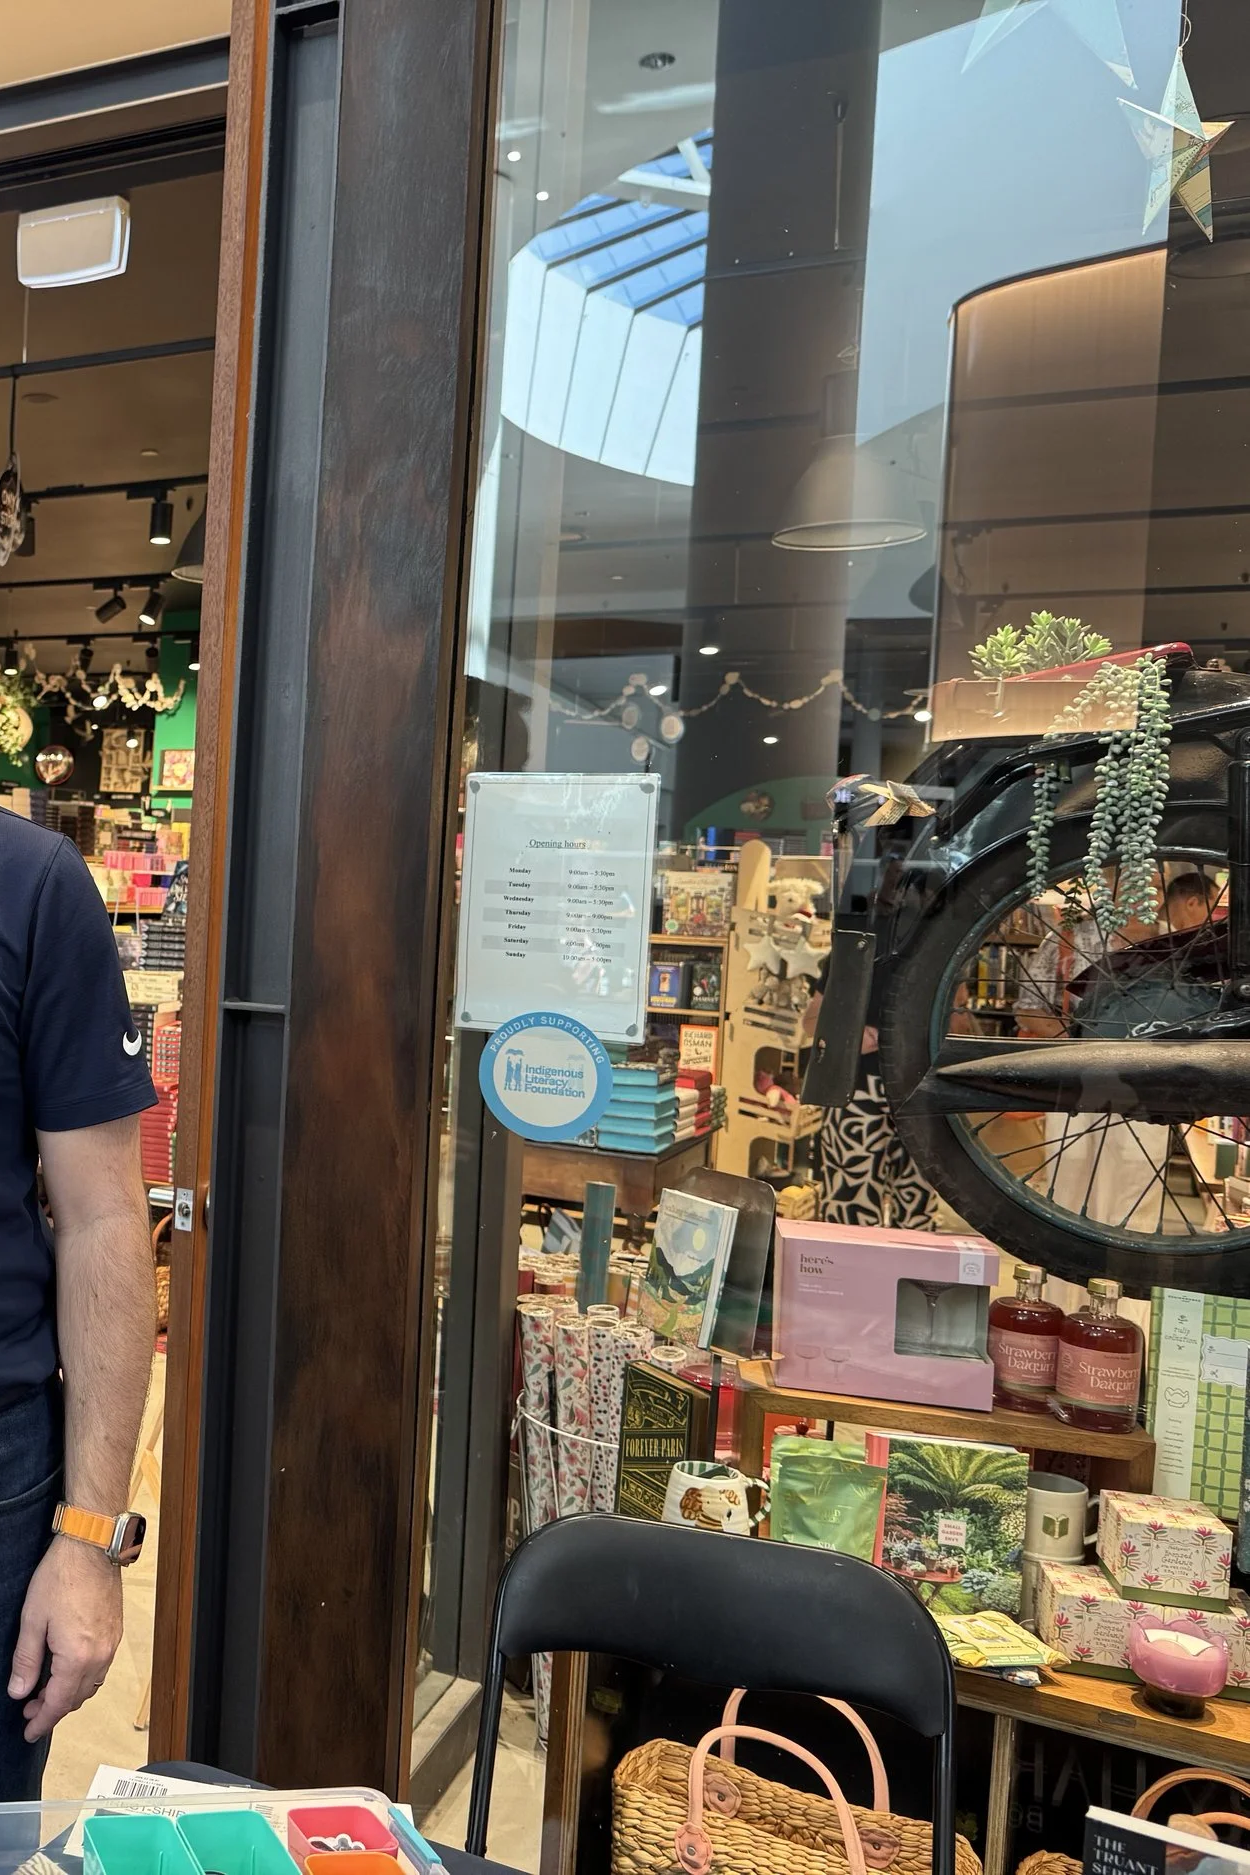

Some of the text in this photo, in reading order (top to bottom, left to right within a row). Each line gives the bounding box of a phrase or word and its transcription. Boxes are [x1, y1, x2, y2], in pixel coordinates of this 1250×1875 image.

[529, 839, 586, 849] Opening hours
[509, 867, 532, 875] Monday
[508, 881, 531, 889] Tuesday
[503, 895, 534, 903] Wednesday
[505, 909, 531, 917] Thursday
[508, 923, 526, 931] Friday
[505, 951, 526, 959] Sunday
[489, 1016, 605, 1065] PROUDLY SUPPORTING
[684, 1039, 712, 1047] OSMAN
[525, 1064, 584, 1079] Indigenous
[524, 1075, 569, 1088] Literacy
[524, 1084, 586, 1099] Foundation
[799, 1263, 823, 1274] how
[625, 1438, 684, 1458] FOREVER PARIS
[1093, 1834, 1127, 1852] THE
[1093, 1848, 1159, 1875] TRUANT
